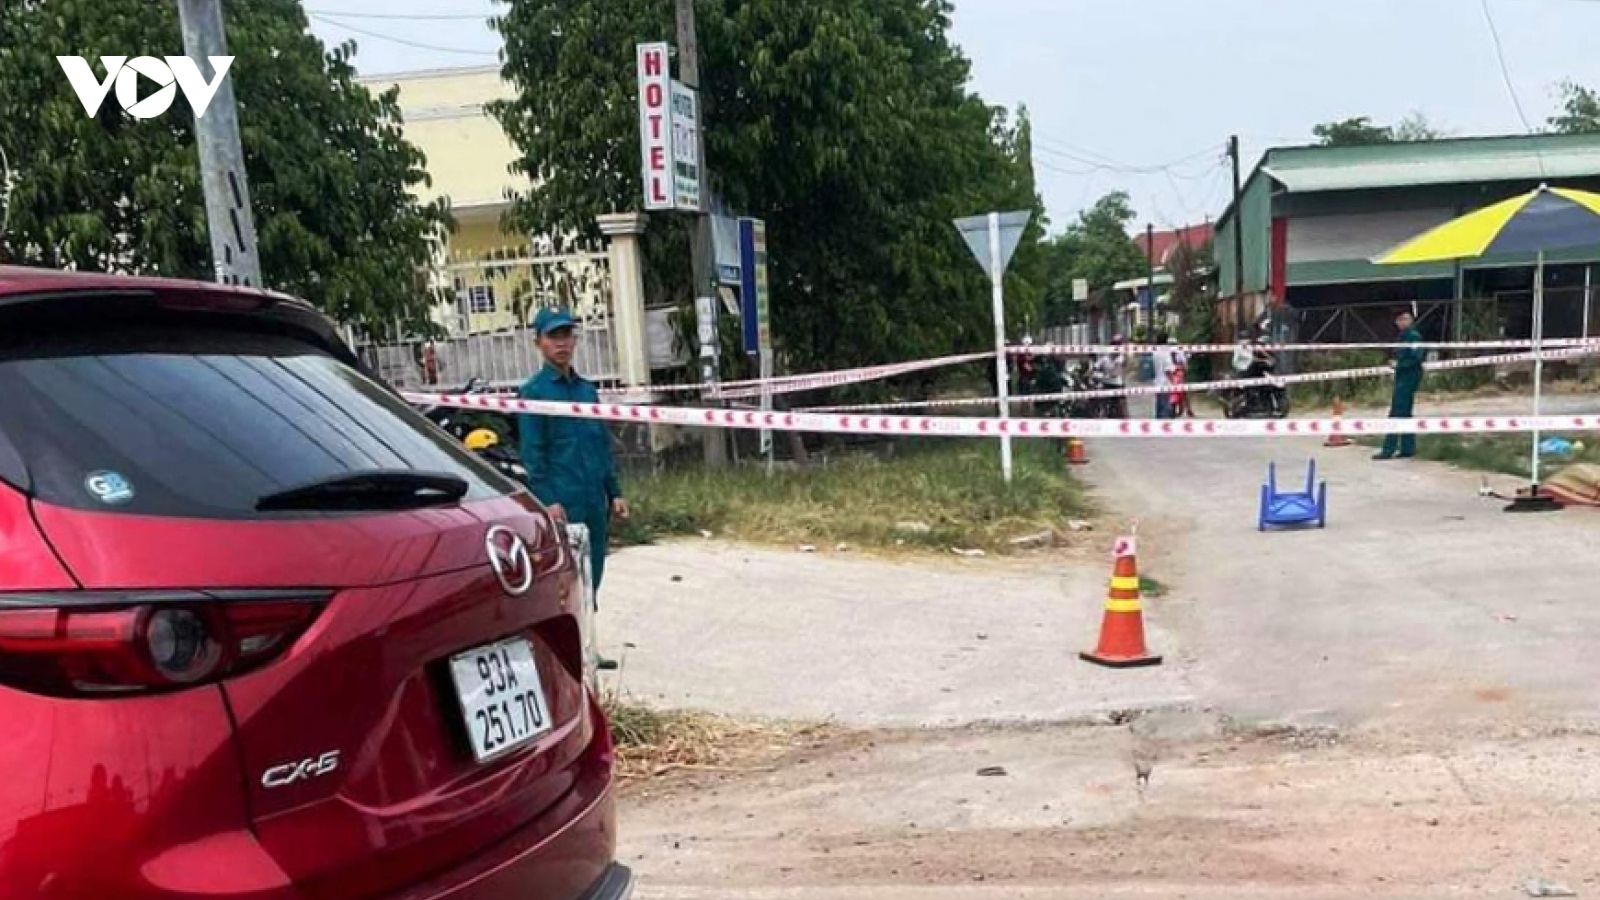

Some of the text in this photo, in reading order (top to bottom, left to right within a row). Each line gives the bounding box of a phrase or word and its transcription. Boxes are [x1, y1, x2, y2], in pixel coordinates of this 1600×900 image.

[644, 51, 667, 203] HOTEL
[476, 648, 518, 697] 93A
[476, 688, 544, 751] 251.70
[261, 749, 341, 788] CX-5
